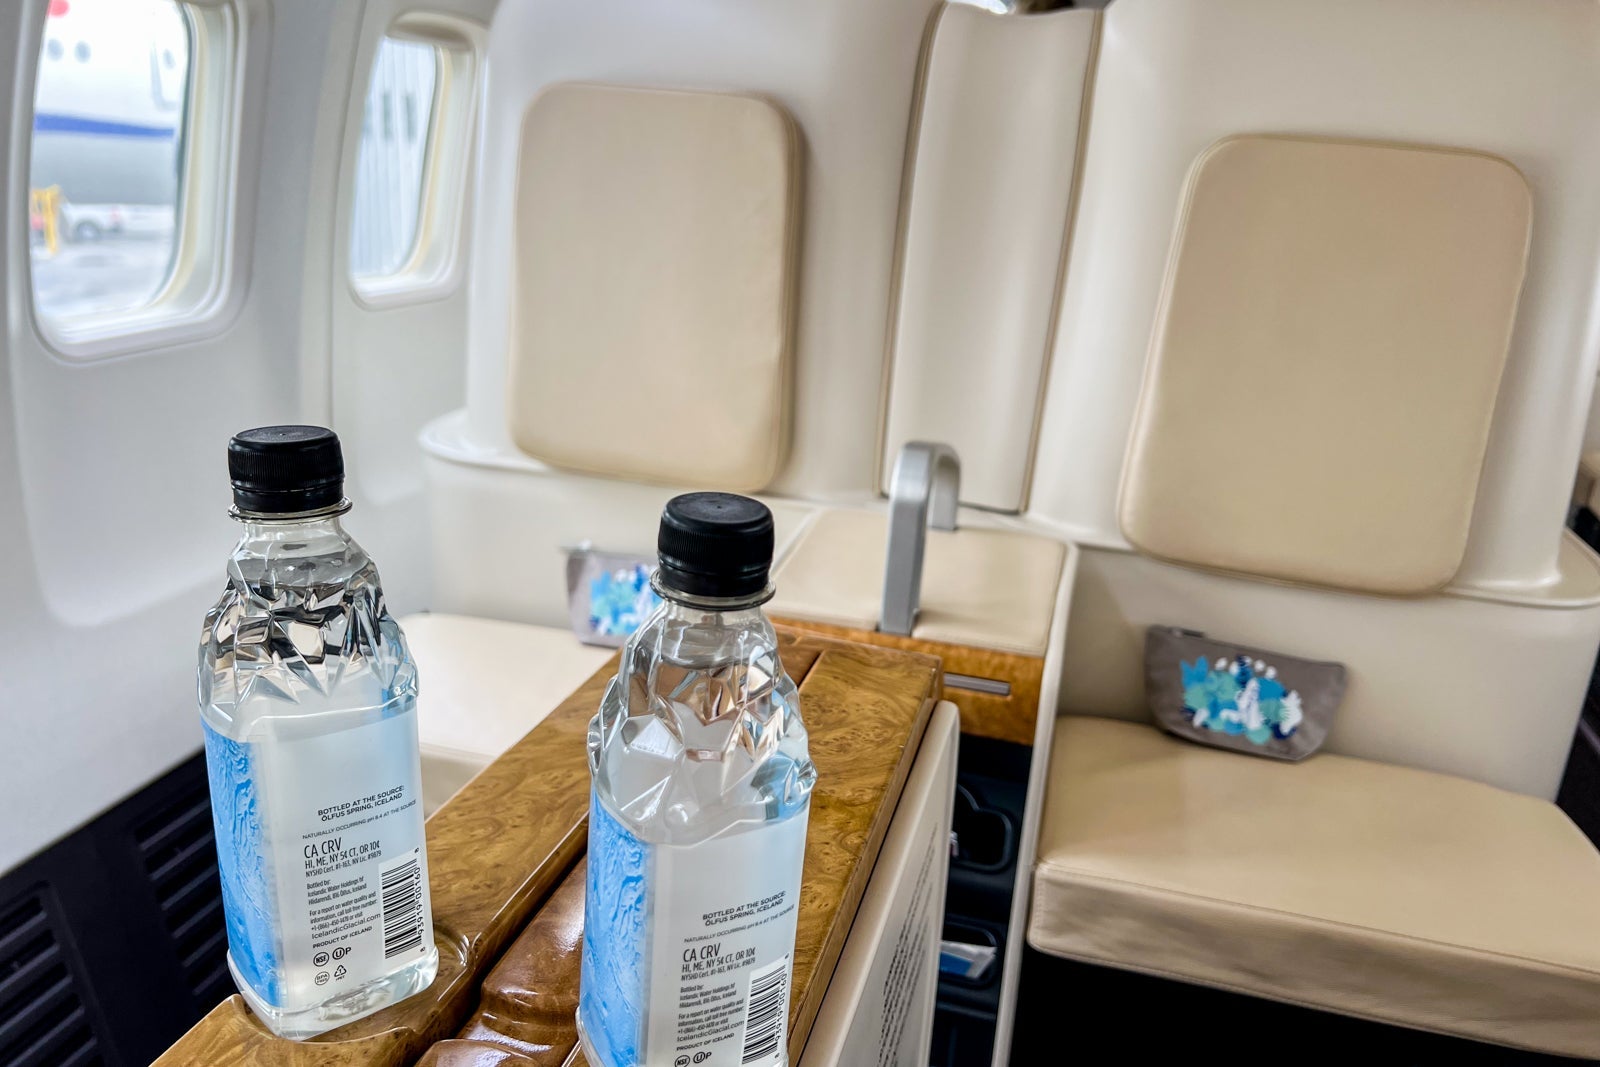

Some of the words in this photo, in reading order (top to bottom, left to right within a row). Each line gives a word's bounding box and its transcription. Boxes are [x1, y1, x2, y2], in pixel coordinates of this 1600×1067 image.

[318, 803, 350, 815] BOTTLED
[363, 795, 376, 803] THE
[322, 811, 345, 821] ÖLFUS
[347, 802, 373, 815] SPRING,
[375, 793, 402, 806] ICELAND
[303, 827, 334, 839] NATURALLY
[336, 819, 366, 831] OCCURRING
[304, 844, 318, 858] CA
[322, 837, 341, 854] CRV
[305, 860, 314, 869] HI,
[316, 858, 328, 867] ME,
[330, 854, 338, 863] NY
[340, 851, 347, 860] 5¢
[349, 847, 358, 857] CT,
[360, 843, 368, 854] OR
[370, 840, 380, 850] 10¢
[306, 868, 323, 877] NYSHD
[307, 880, 323, 890] Bottled
[321, 903, 334, 914] report
[341, 899, 353, 909] water
[354, 895, 368, 904] quality
[368, 891, 376, 899] and
[703, 908, 734, 920] BOTTLED
[747, 901, 759, 909] THE
[730, 909, 755, 921] SPRING,
[757, 898, 783, 912] ICELAND
[312, 913, 380, 939] IcelandicGlacial.com
[416, 904, 424, 935] 93919
[313, 937, 339, 948] PRODUCT
[350, 926, 372, 937] ICELAND
[684, 933, 715, 943] NATURALLY
[717, 925, 746, 937] OCCURRING
[682, 964, 691, 973] HI,
[693, 962, 704, 971] ME,
[706, 958, 715, 968] NY
[717, 957, 724, 965] 5¢
[725, 954, 734, 964] CT,
[736, 950, 745, 958] OR
[683, 948, 696, 962] CA
[701, 943, 720, 959] CRV
[677, 1020, 744, 1042] IcelandicGlacial.com
[677, 1042, 703, 1050] PRODUCT
[712, 1033, 735, 1042] ICELAND
